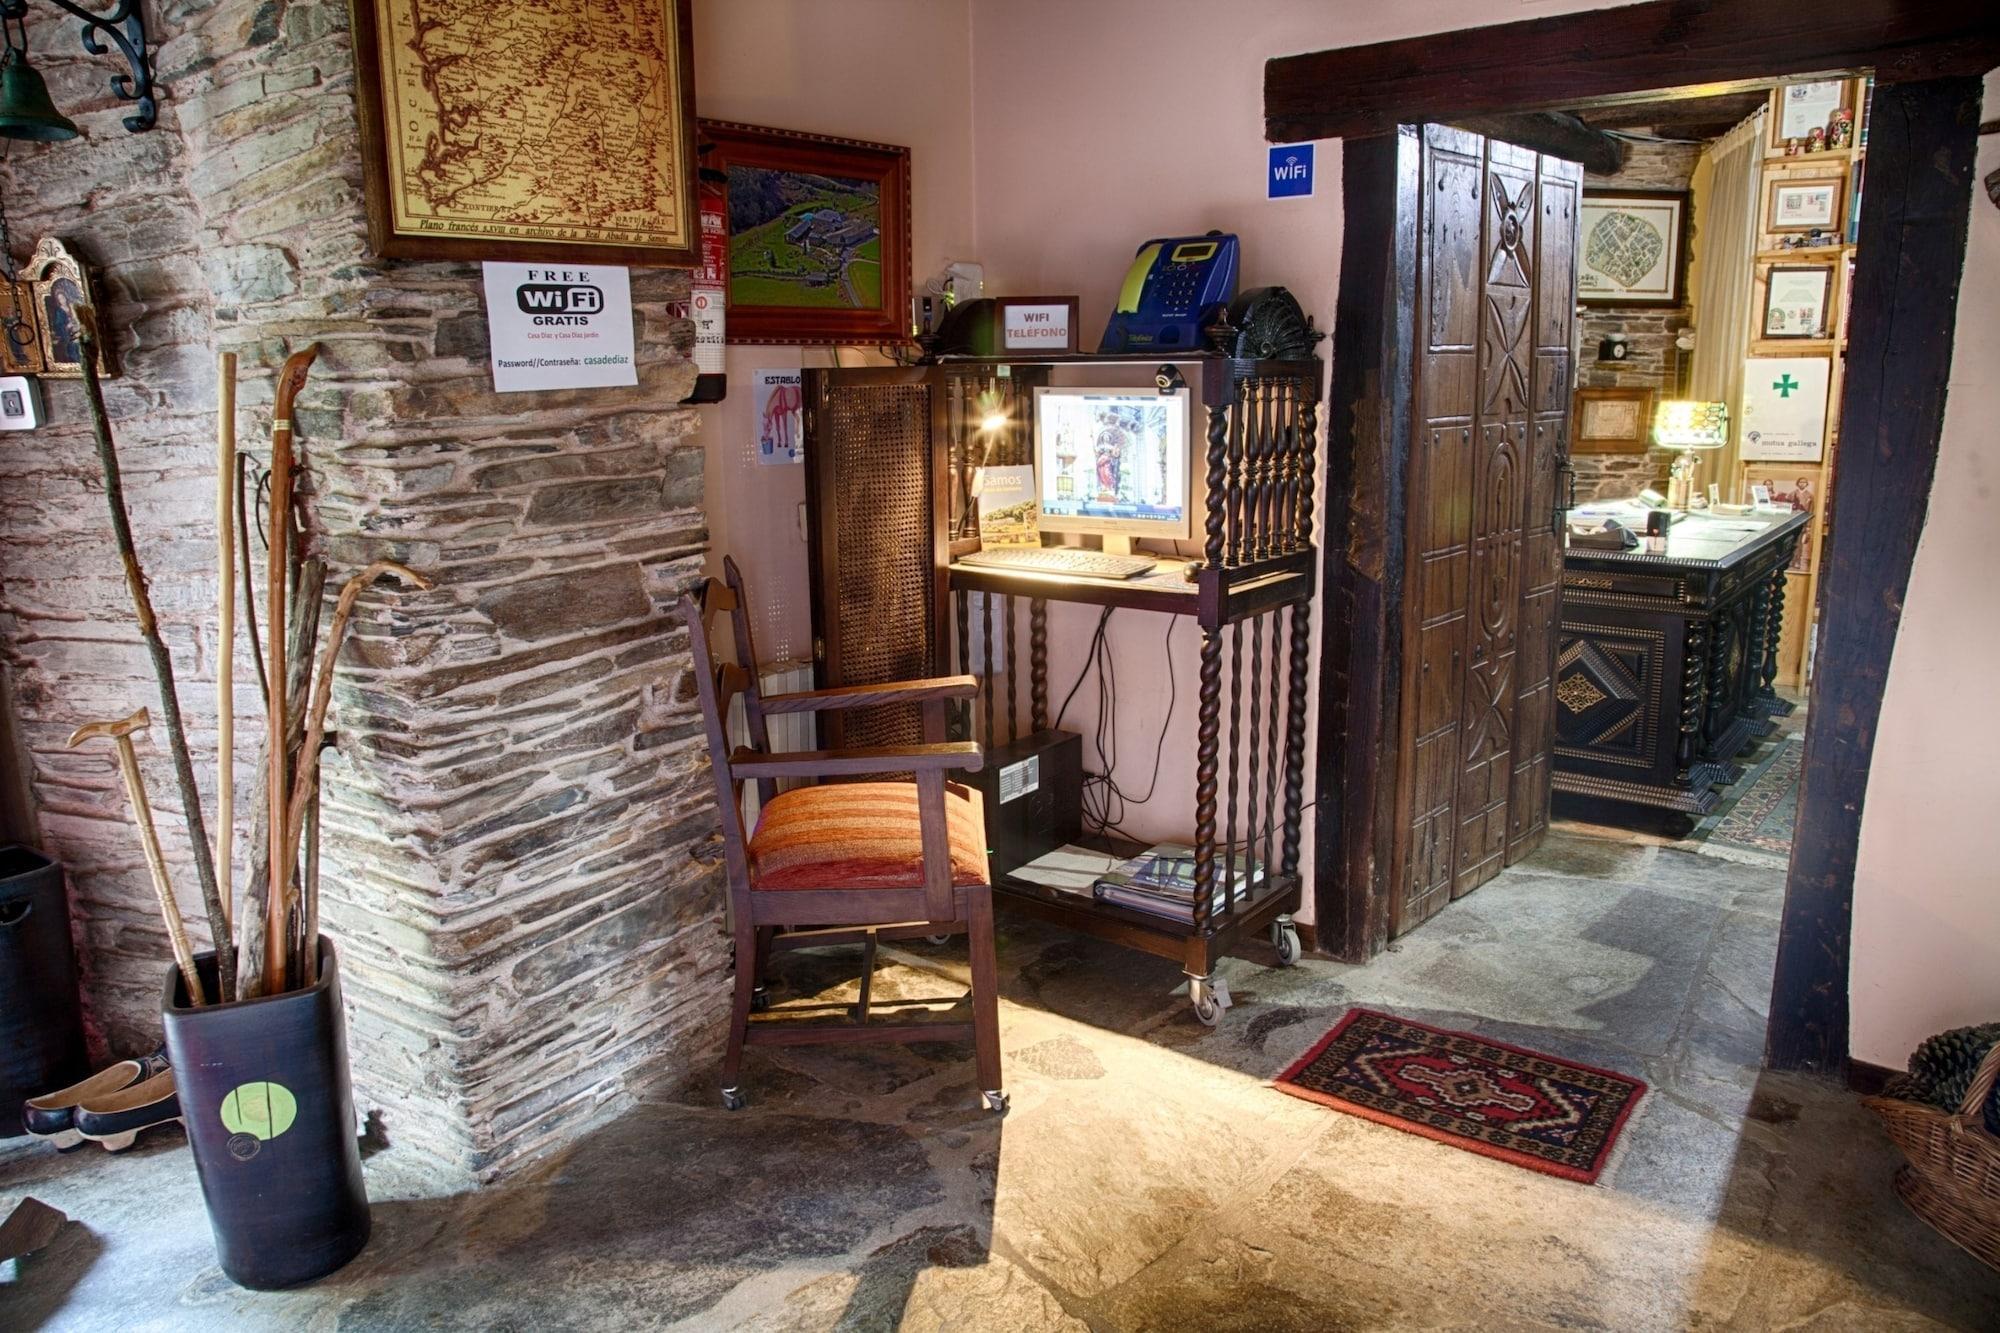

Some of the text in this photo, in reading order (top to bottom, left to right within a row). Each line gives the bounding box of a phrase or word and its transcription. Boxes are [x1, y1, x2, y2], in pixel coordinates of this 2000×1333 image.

[1274, 165, 1306, 181] WiFi
[420, 219, 444, 230] Plano
[509, 226, 519, 234] en
[526, 225, 554, 237] archivo
[557, 228, 567, 237] de
[570, 228, 577, 237] la
[585, 229, 601, 238] Real
[633, 232, 643, 241] de
[528, 270, 590, 282] FREE
[523, 290, 596, 308] WiFi
[533, 316, 588, 326] GRATIS
[1024, 313, 1050, 322] WIFI
[1007, 326, 1067, 338] TELÉFONO
[498, 355, 629, 368] Password//Contraseña: casadediaz
[984, 476, 1022, 486] Samos
